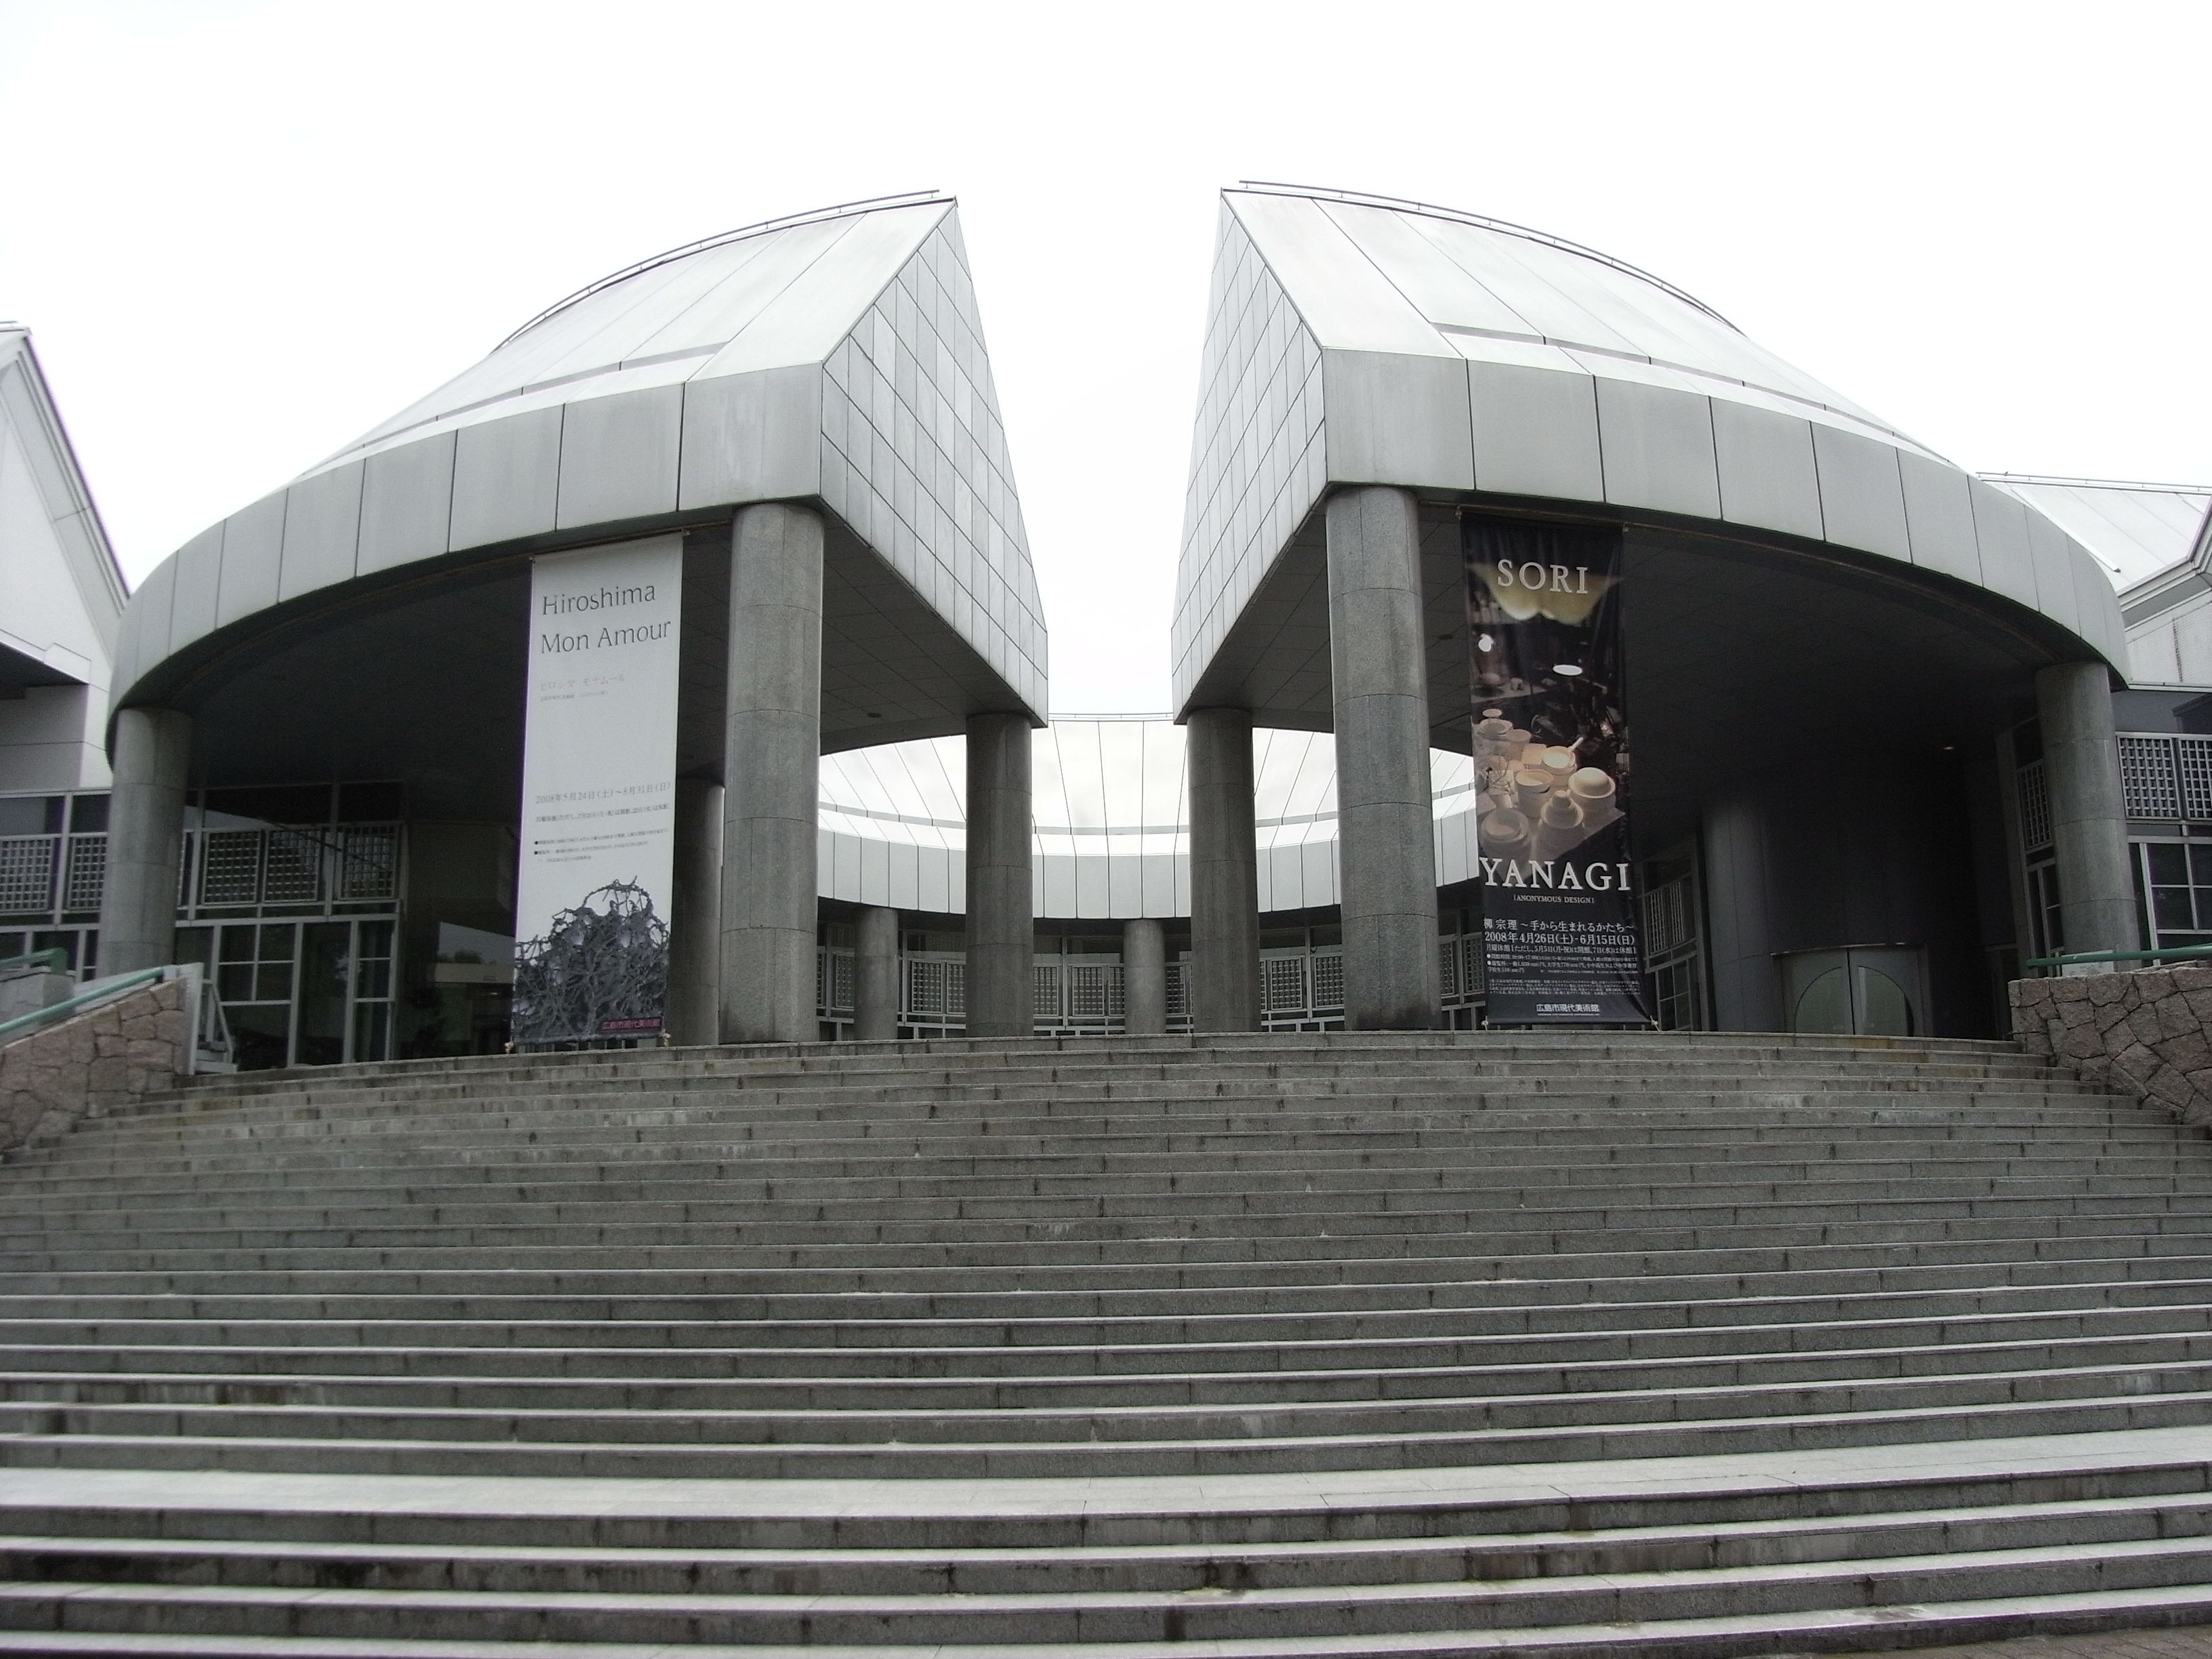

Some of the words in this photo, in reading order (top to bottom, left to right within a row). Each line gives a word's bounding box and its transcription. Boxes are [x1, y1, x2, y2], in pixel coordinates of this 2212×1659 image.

[1496, 558, 1589, 594] SORI
[542, 585, 655, 615] Hiroshima
[541, 634, 590, 654] Mon
[597, 621, 672, 648] Amour
[1479, 857, 1631, 891] YANAGI
